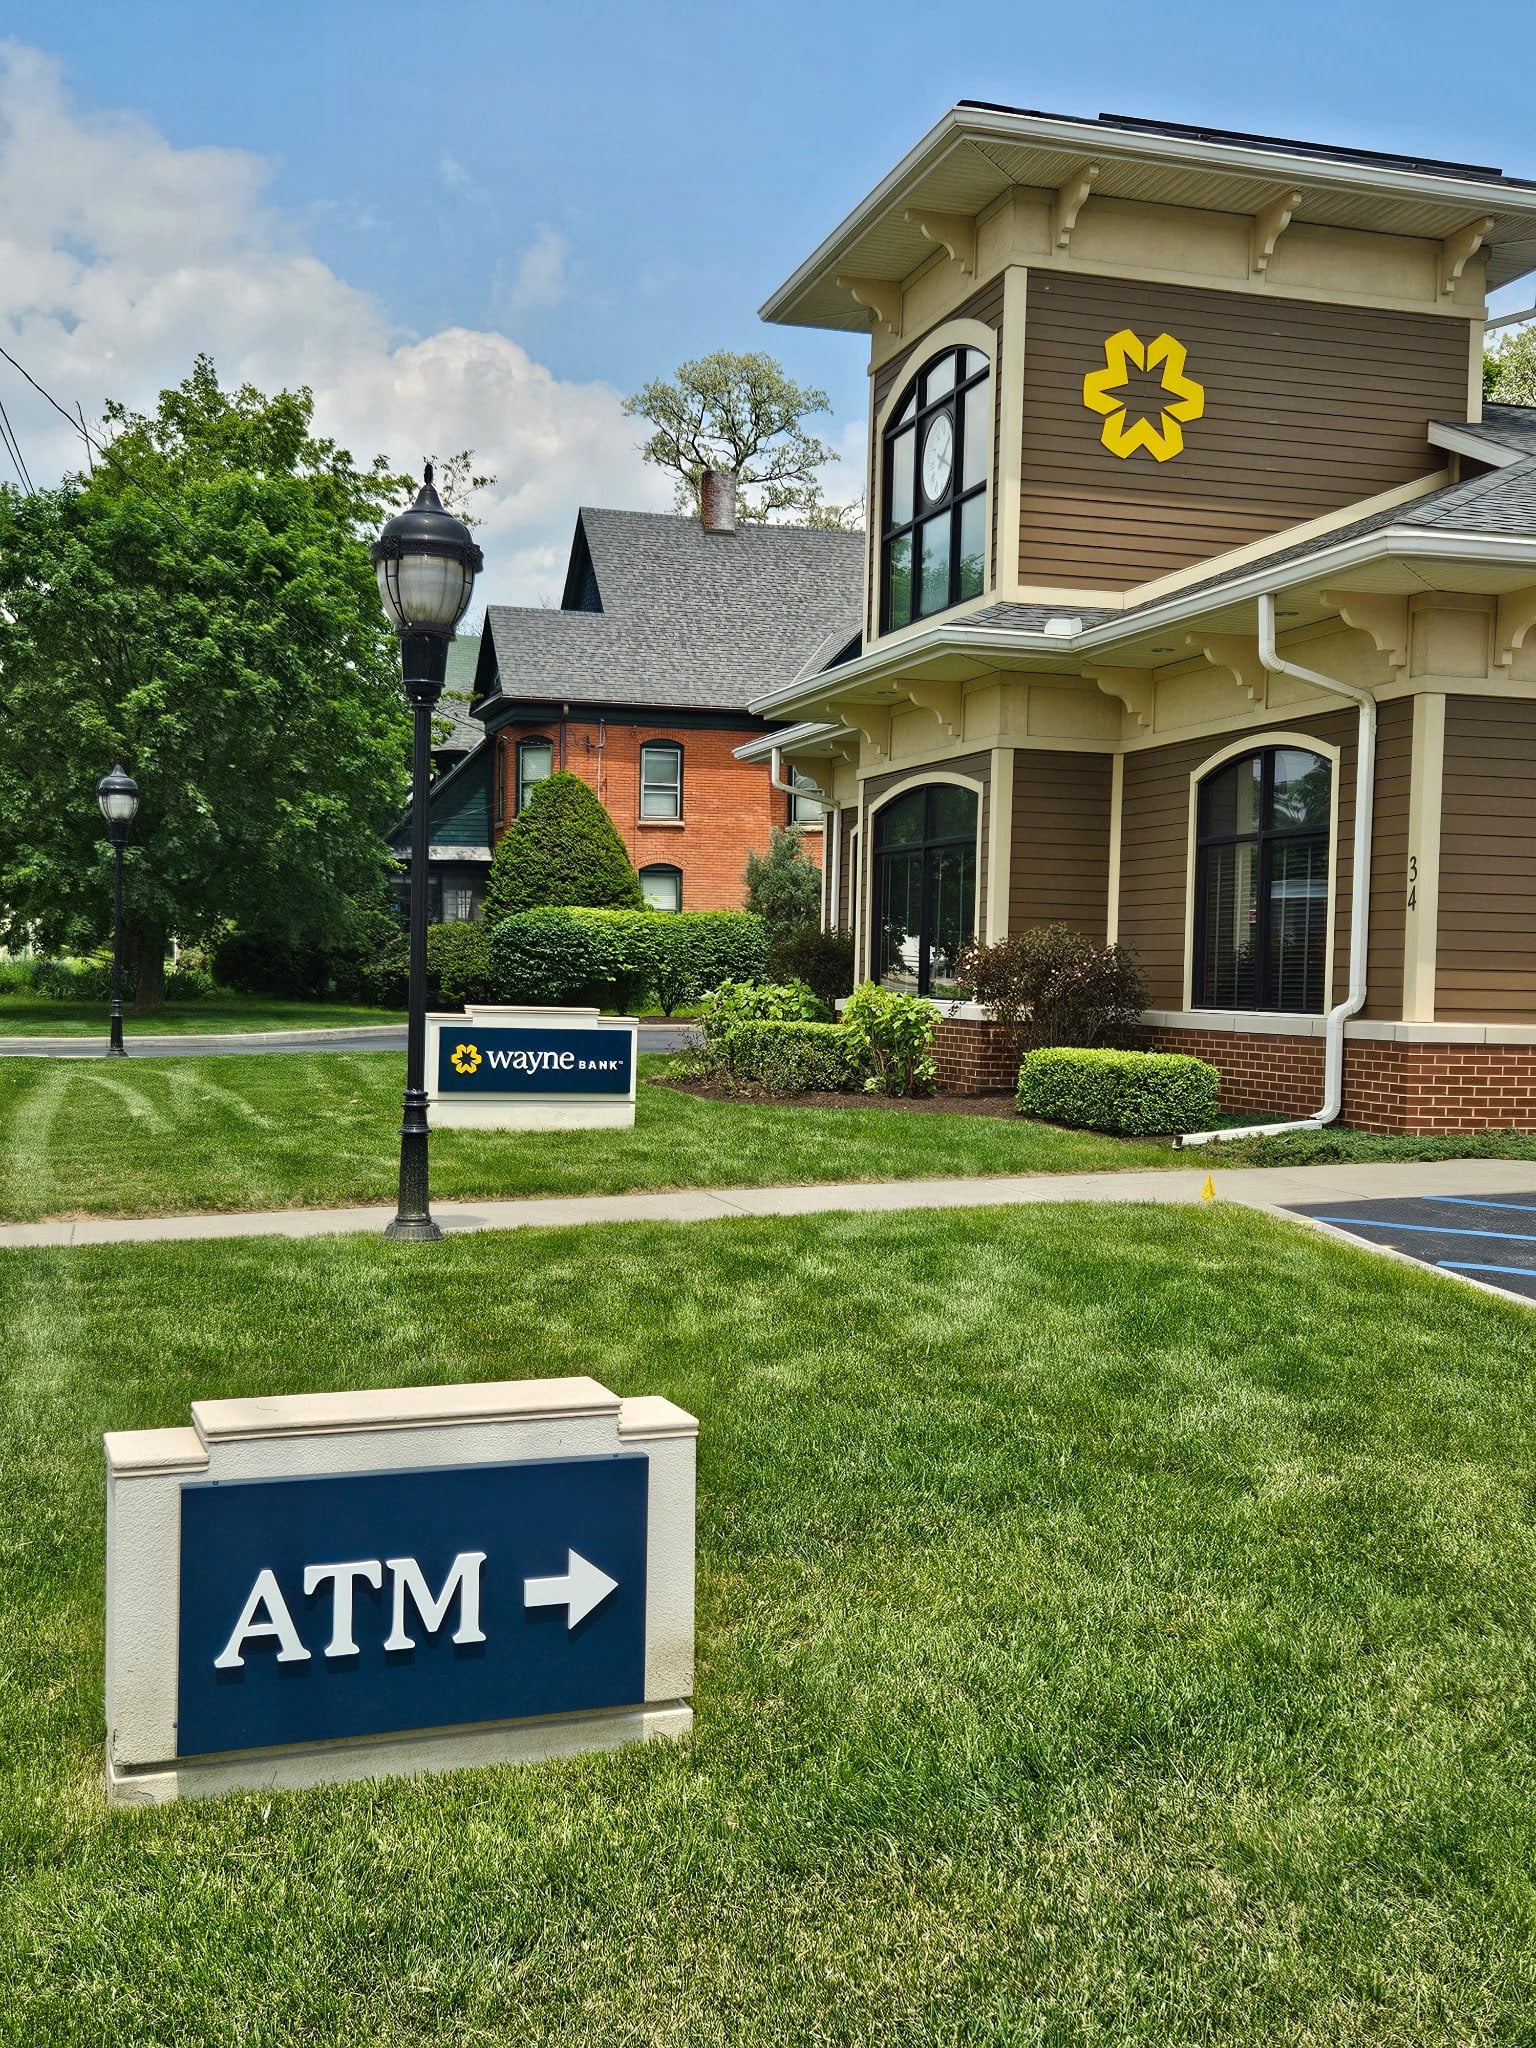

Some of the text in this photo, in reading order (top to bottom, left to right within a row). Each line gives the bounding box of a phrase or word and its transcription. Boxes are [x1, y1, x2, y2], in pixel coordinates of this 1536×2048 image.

[1407, 855, 1418, 912] 34
[485, 1050, 618, 1075] wayne BANK
[213, 1551, 488, 1669] ATM
